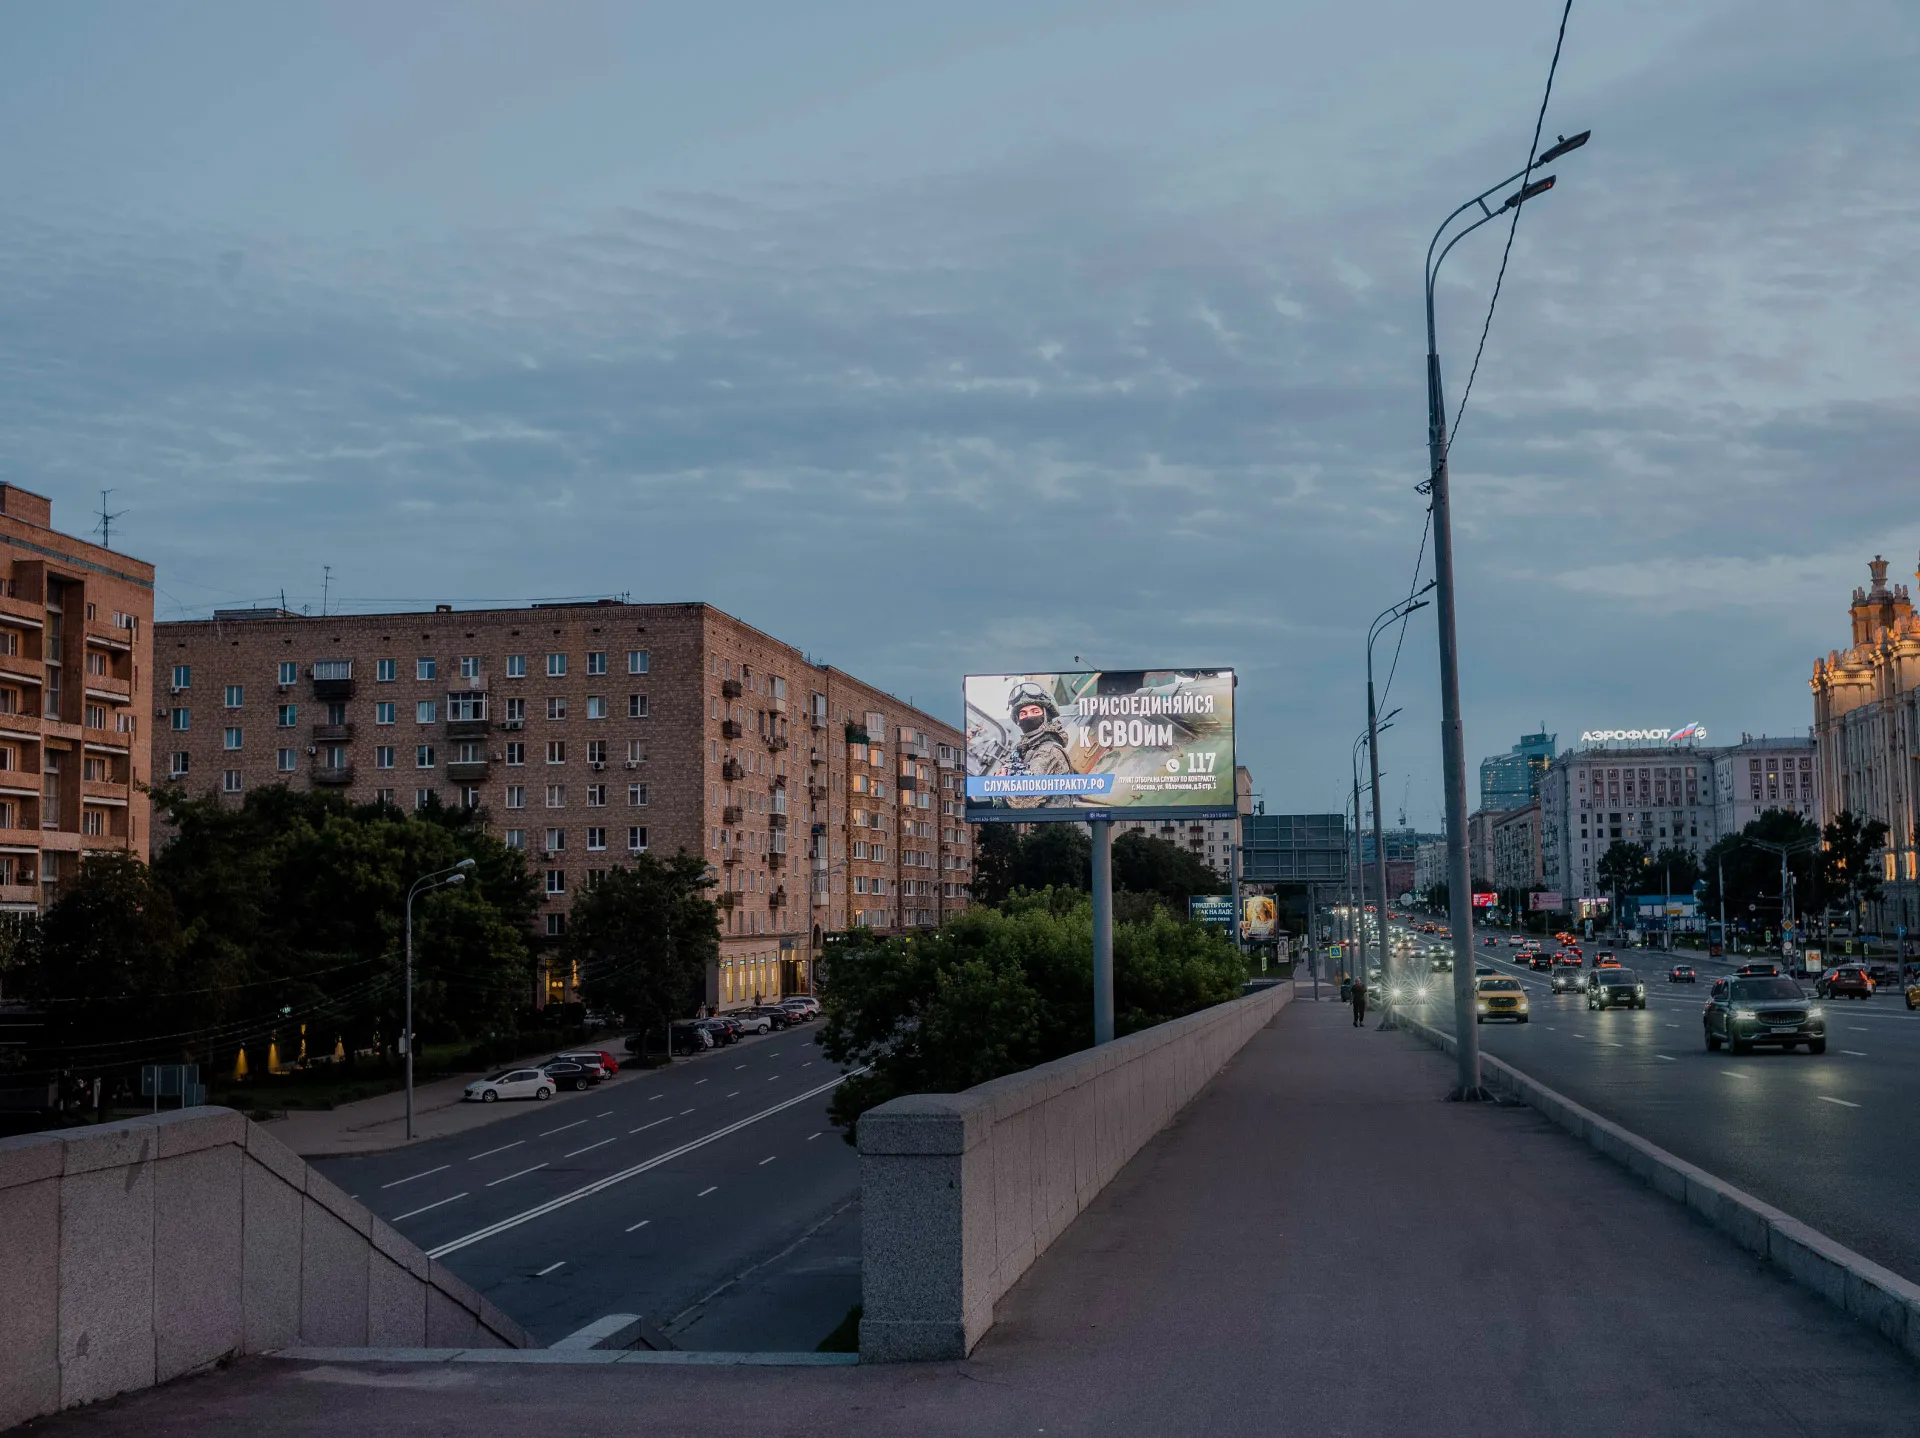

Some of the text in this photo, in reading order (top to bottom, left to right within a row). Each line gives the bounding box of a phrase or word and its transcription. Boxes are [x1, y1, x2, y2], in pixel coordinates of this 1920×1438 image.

[1079, 692, 1214, 716] ПРИСОЕДИНЯЙСЯ
[1581, 729, 1671, 741] АЭРОФЛОТ
[1187, 752, 1217, 773] 117
[984, 777, 1105, 792] СЛУЖБАПОКОНТРАКТУ.РФ
